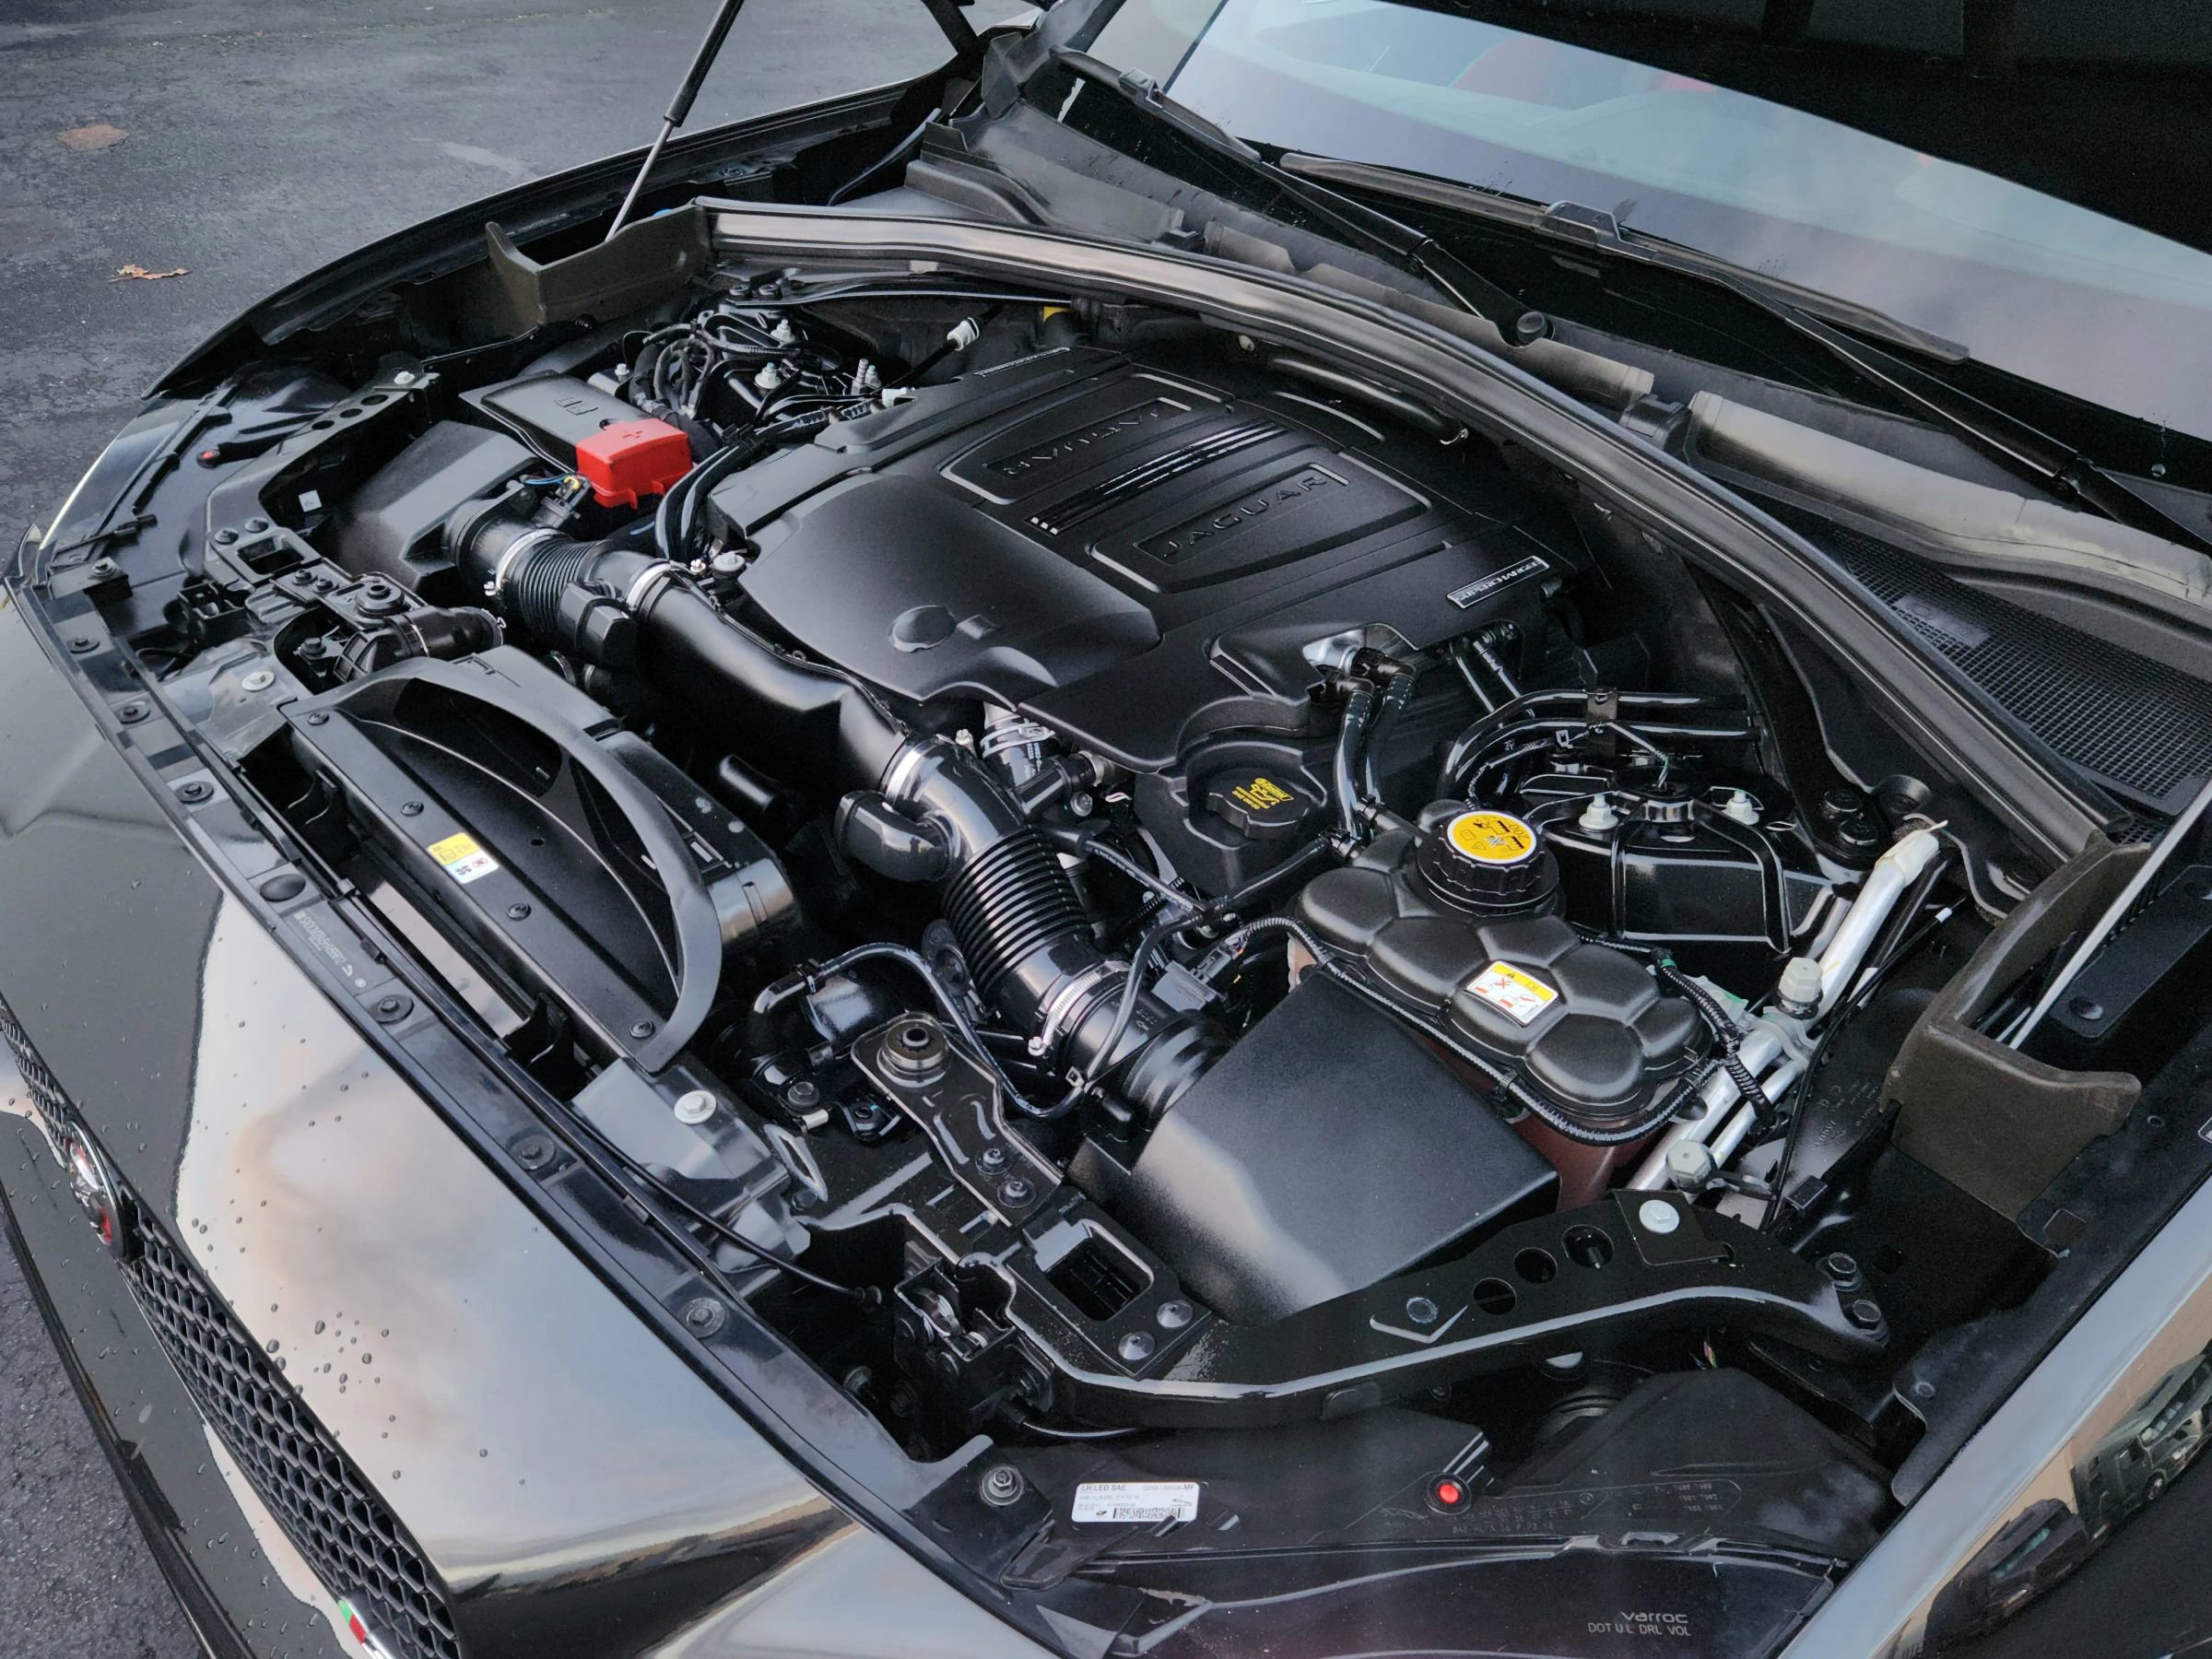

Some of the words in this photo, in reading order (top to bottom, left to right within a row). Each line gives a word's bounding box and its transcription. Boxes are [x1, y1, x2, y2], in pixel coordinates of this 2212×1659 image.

[1163, 476, 1328, 558] JAGUAR
[1620, 1611, 1689, 1624] varroc
[1587, 1622, 1612, 1633] DOT
[1639, 1624, 1663, 1635] DRL
[1666, 1625, 1692, 1637] VOL
